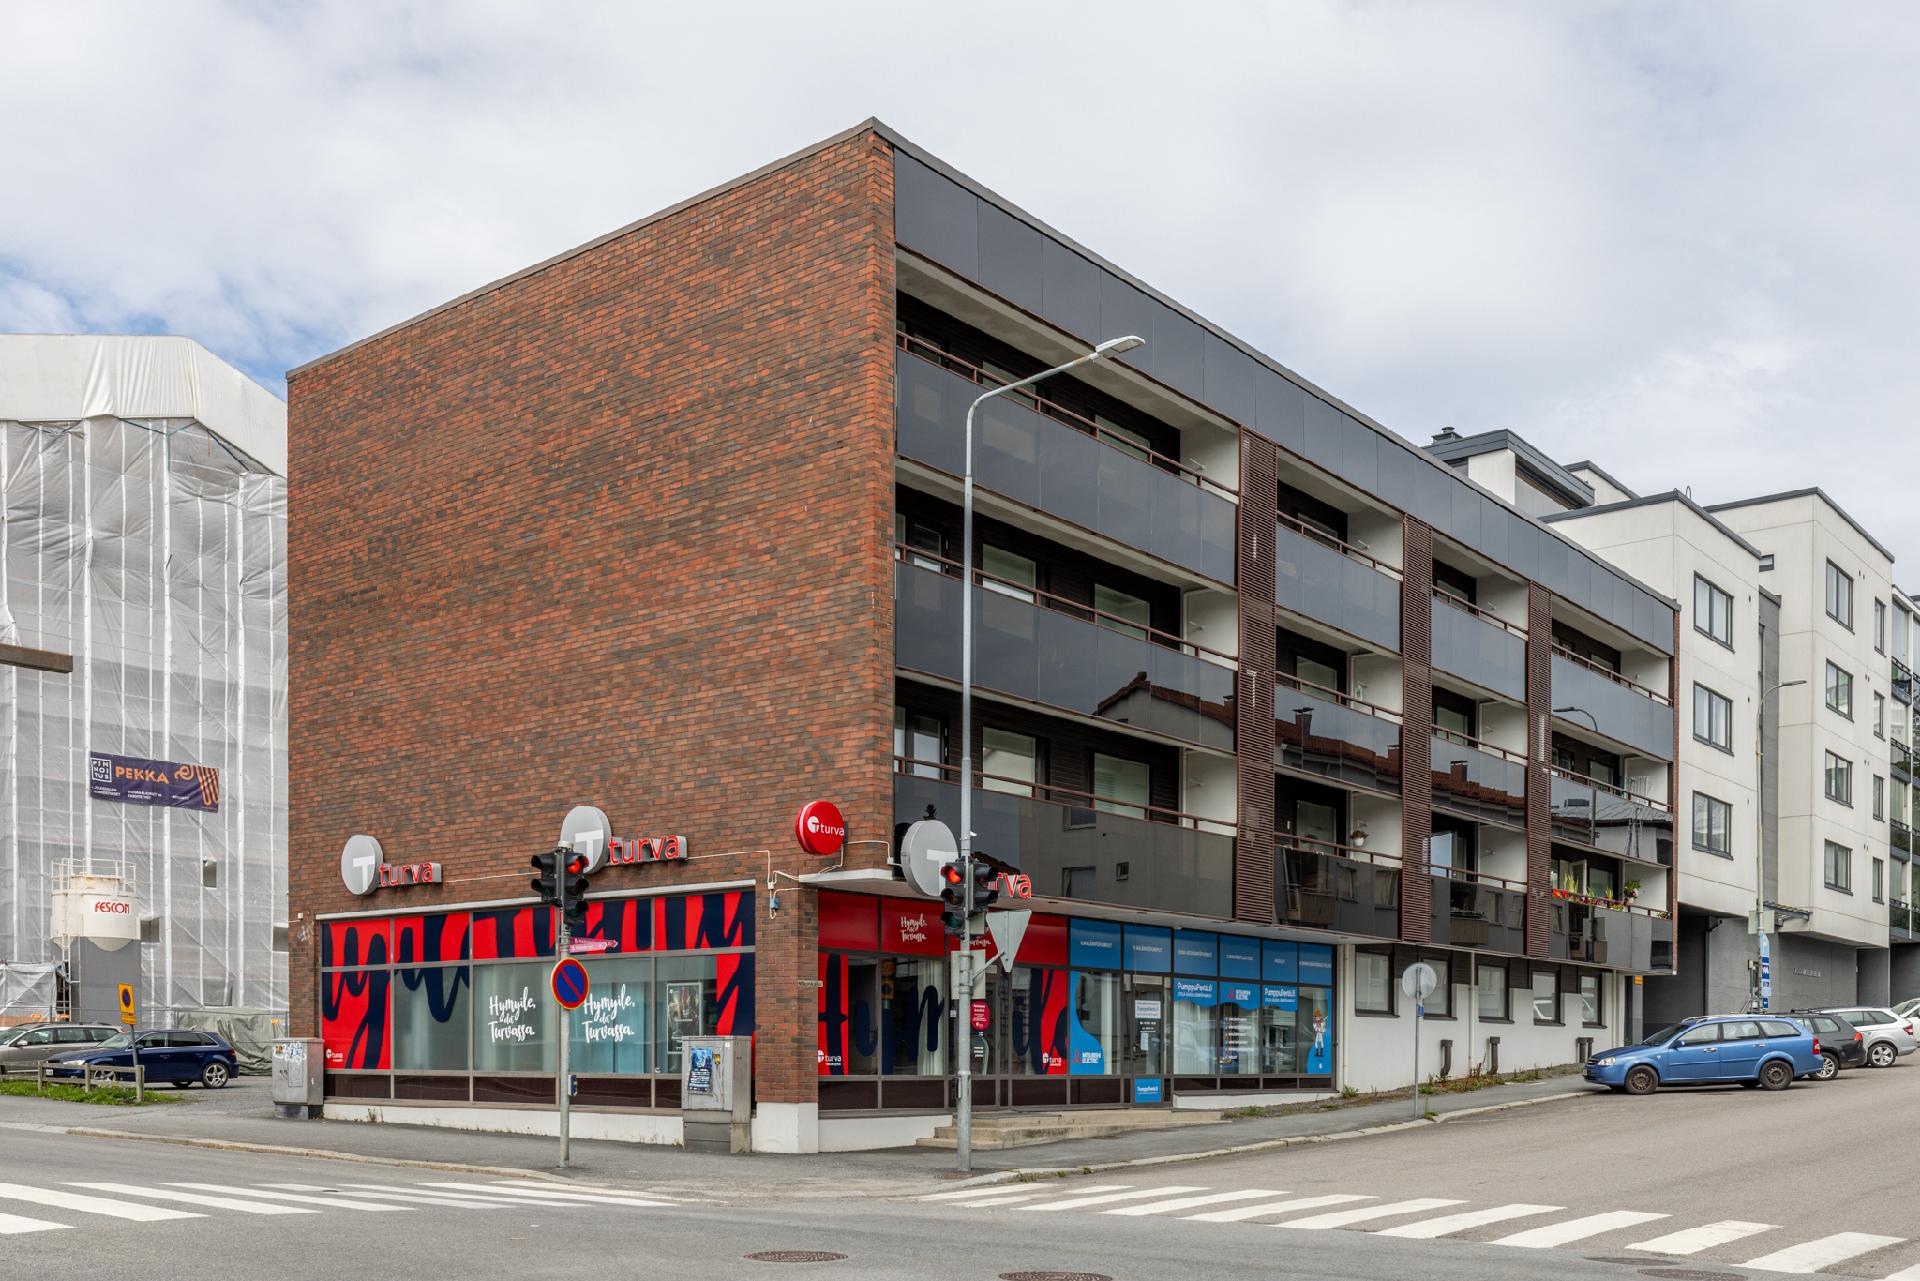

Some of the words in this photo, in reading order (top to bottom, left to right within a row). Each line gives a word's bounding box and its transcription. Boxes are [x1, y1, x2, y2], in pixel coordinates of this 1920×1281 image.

[115, 766, 170, 785] PEKKA
[820, 823, 845, 836] turva
[607, 835, 680, 865] turva
[379, 862, 434, 887] turva
[95, 901, 130, 914] FESCON
[489, 986, 536, 1022] Hymyile,
[583, 984, 635, 1021] Hymyile,
[488, 1020, 535, 1043] Turvassa.
[581, 1020, 635, 1044] Turvassa.
